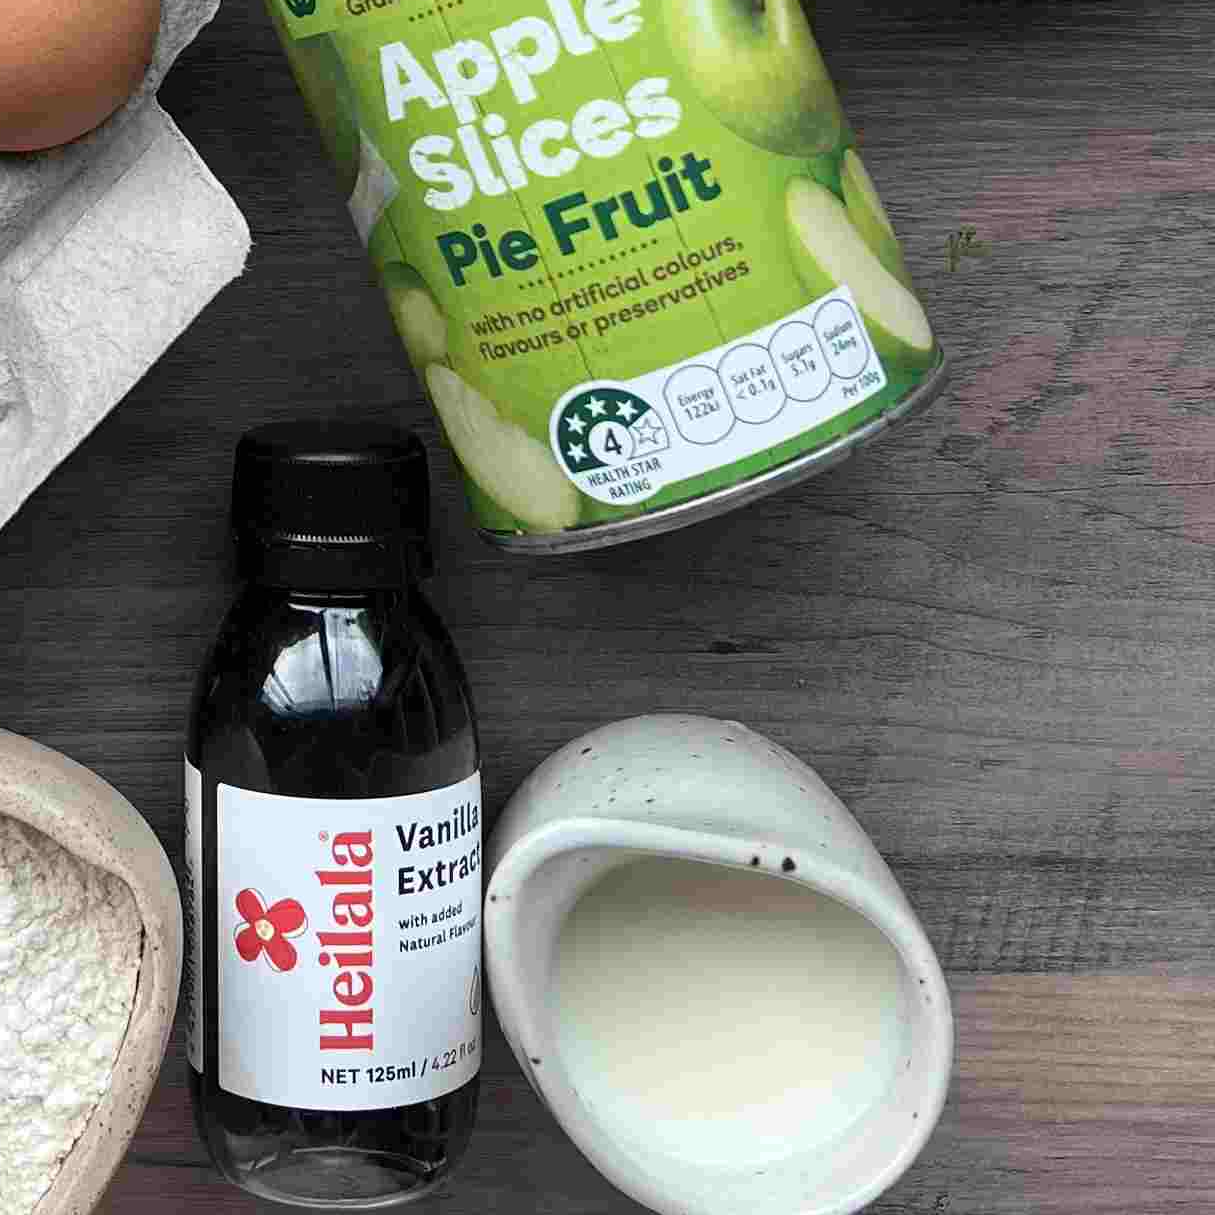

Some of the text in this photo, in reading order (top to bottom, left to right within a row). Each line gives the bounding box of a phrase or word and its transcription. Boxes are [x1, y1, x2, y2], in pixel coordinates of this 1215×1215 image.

[436, 150, 722, 288] Pie Fruit
[470, 235, 745, 337] with no artificial colours,
[479, 258, 751, 361] flavours or preservatives
[781, 342, 815, 364] Sugars
[730, 363, 767, 386] Sat Fat
[604, 427, 623, 455] 4
[587, 456, 663, 487] HEALTH STAR
[608, 478, 651, 500] RATING
[395, 801, 479, 853] Vanilla
[398, 898, 463, 930] with added
[314, 828, 374, 1051] Heilala
[399, 929, 446, 953] Natural
[321, 1068, 361, 1085] NET
[365, 1060, 416, 1083] 125ml
[431, 1048, 457, 1072] 4.22
